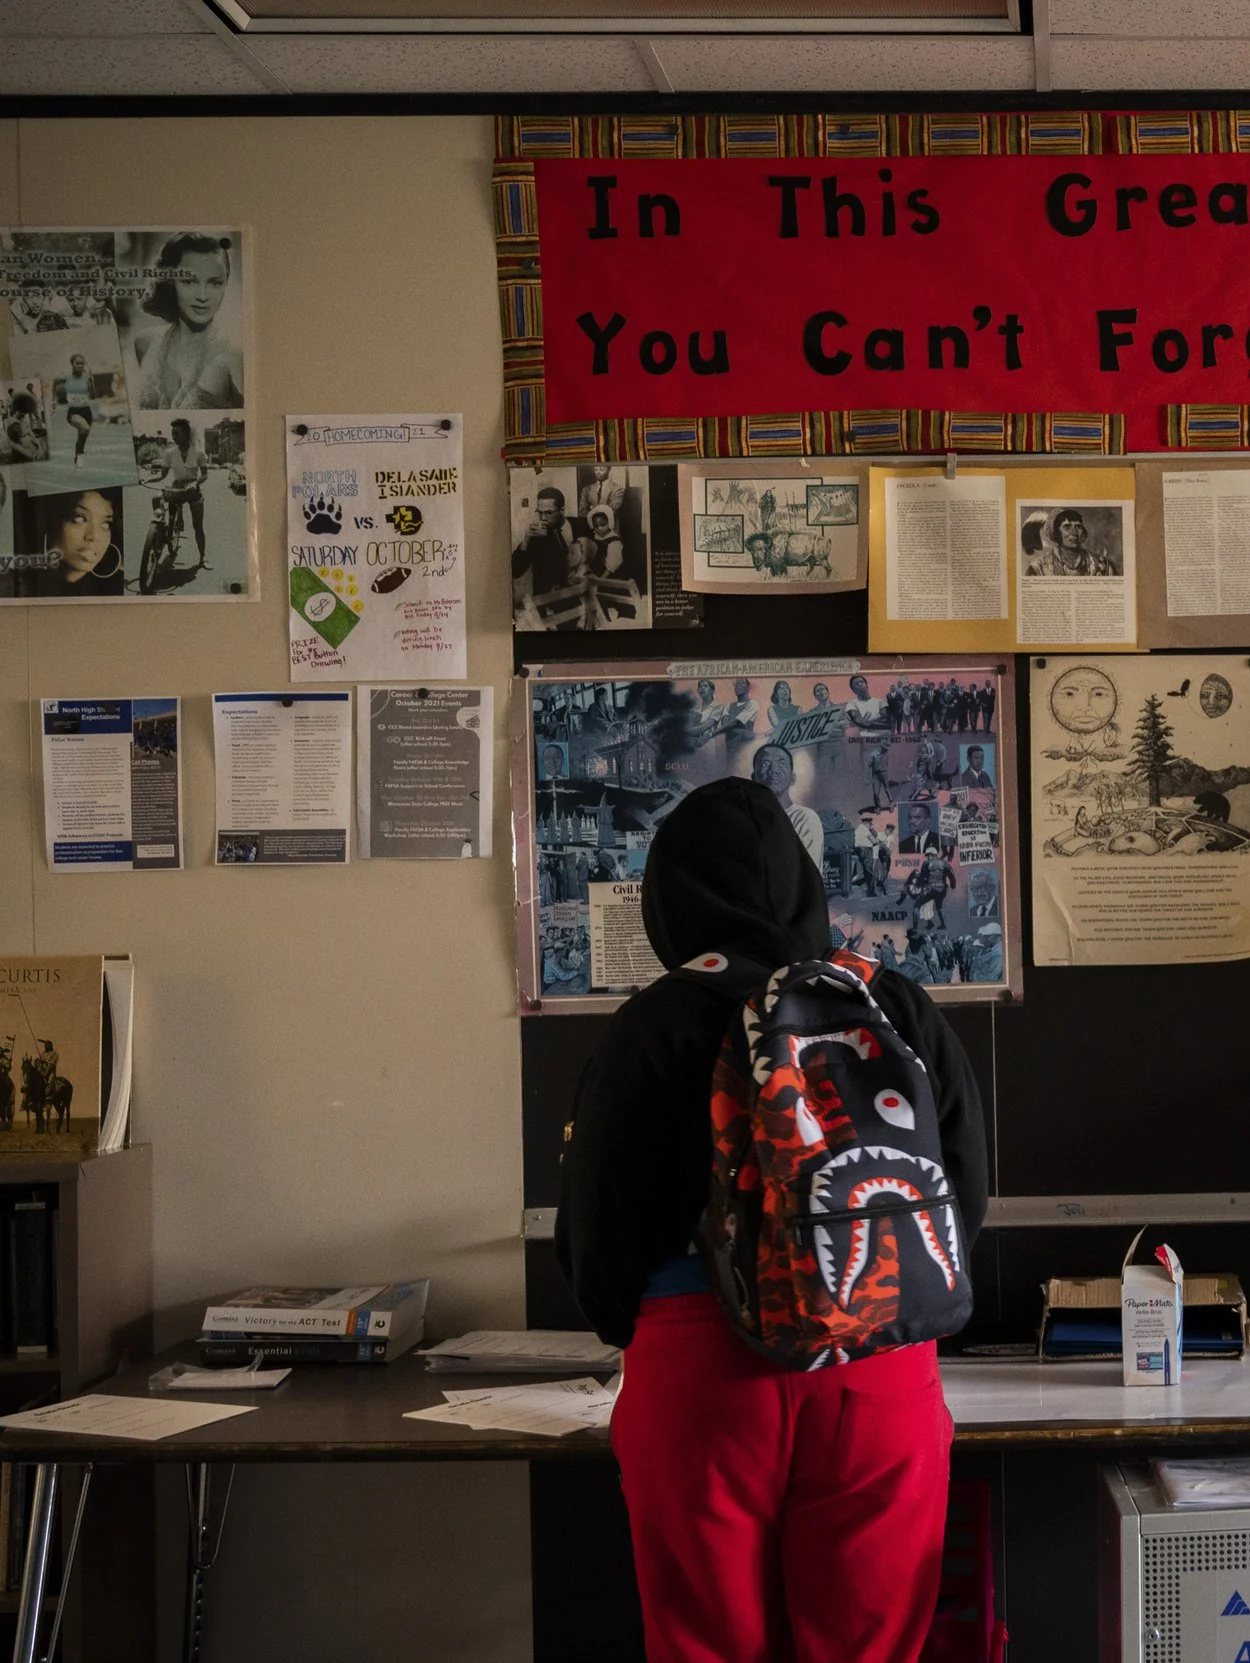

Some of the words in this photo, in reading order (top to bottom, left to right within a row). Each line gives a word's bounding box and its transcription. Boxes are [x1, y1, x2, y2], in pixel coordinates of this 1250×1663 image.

[587, 175, 681, 240] In
[769, 168, 940, 239] This
[70, 269, 100, 280] and
[104, 269, 138, 279] Civil
[142, 268, 198, 281] Rights.
[56, 286, 75, 298] of
[78, 286, 151, 300] History.
[576, 311, 731, 376] You
[803, 304, 1025, 376] Can't
[327, 428, 406, 442] HOMECOMING!
[302, 469, 357, 485] NORTH
[291, 484, 359, 499] POLARS
[291, 545, 359, 567] SATURDAY
[291, 637, 320, 648] PRIZE
[772, 708, 841, 746] JUSTICE
[960, 850, 993, 862] INFERIOR
[612, 885, 633, 894] Civil
[872, 911, 908, 922] NAACP
[1125, 1298, 1149, 1308] Paper
[1152, 1299, 1173, 1307] Mate
[244, 1316, 277, 1327] Victory
[298, 1317, 317, 1327] ACT
[322, 1318, 341, 1327] Test
[248, 1347, 292, 1357] Essential
